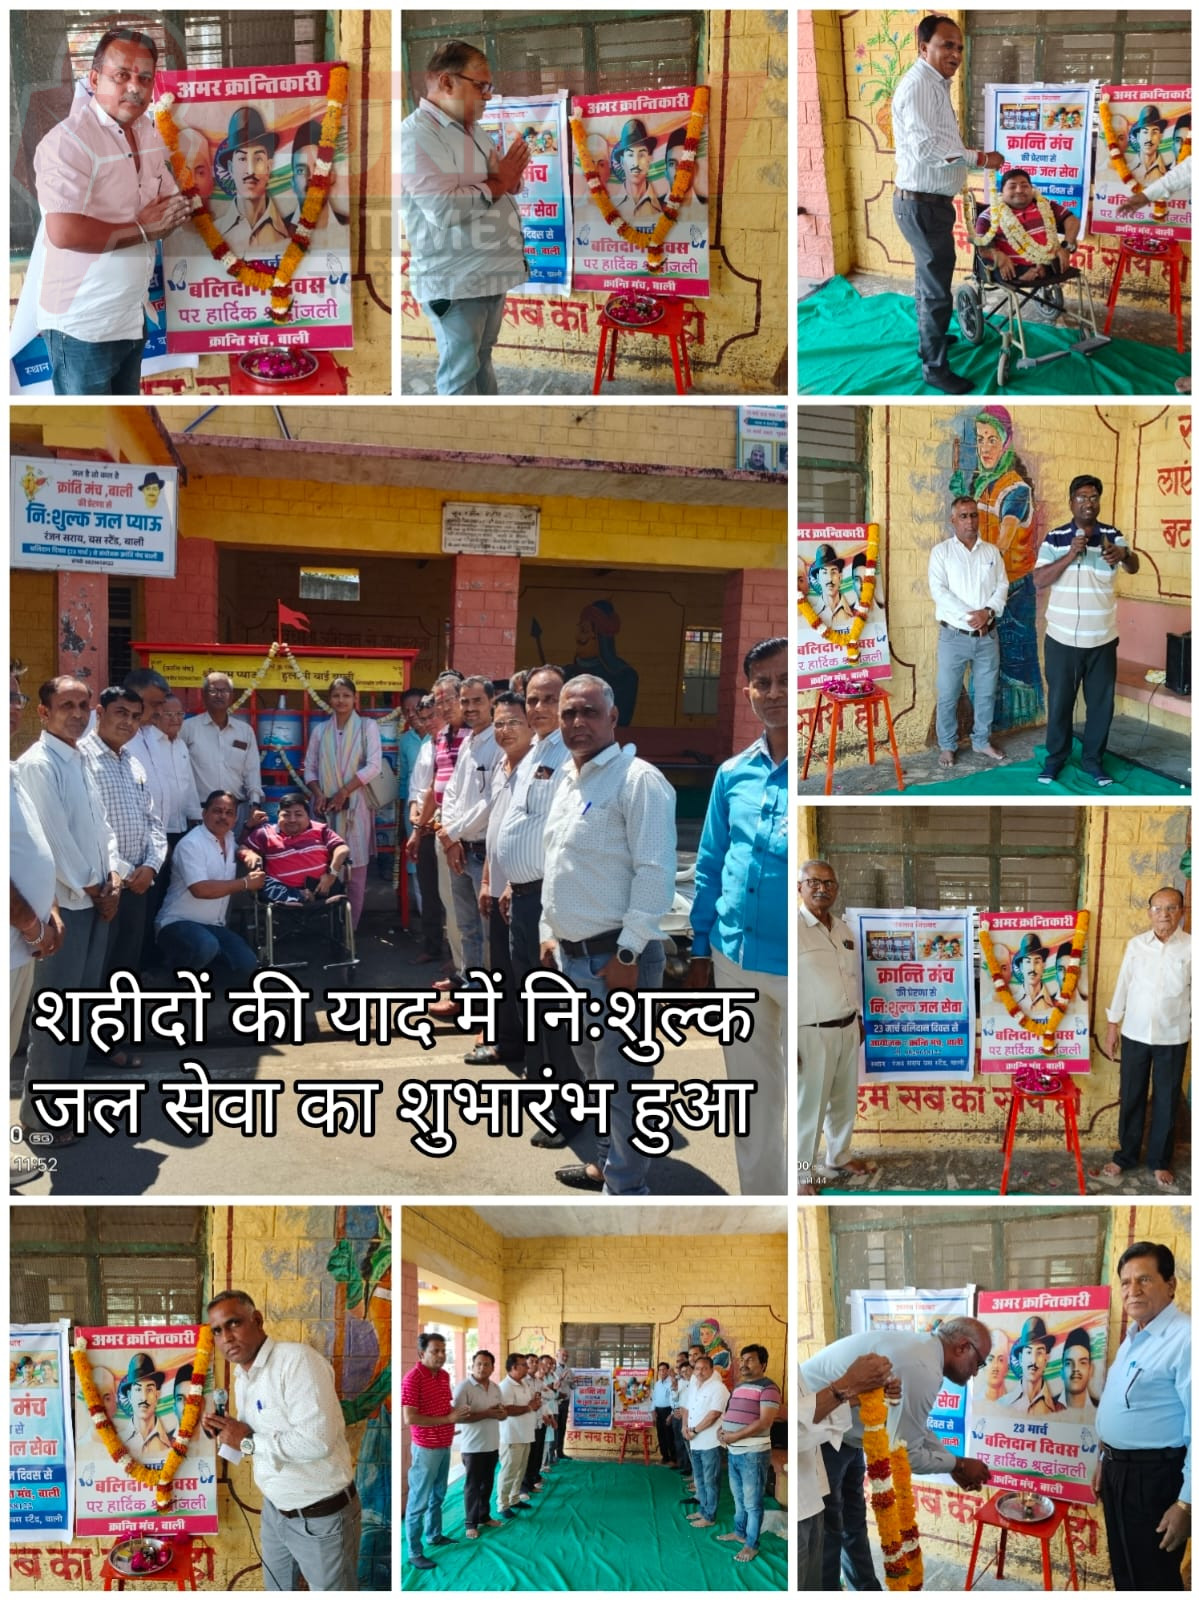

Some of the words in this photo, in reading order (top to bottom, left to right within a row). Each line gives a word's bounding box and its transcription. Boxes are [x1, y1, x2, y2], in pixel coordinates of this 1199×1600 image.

[177, 77, 224, 98] अमर
[225, 71, 322, 96] क्रान्तिकारी
[1113, 90, 1138, 100] अमर
[587, 101, 617, 114] अमर
[619, 93, 690, 111] क्रान्तिकारी
[1006, 132, 1047, 150] क्रान्ति
[1049, 134, 1074, 150] मंच
[1040, 165, 1057, 178] जल
[1059, 164, 1079, 178] सेवा
[534, 200, 557, 217] सेवा
[584, 259, 598, 270] पर
[602, 256, 638, 271] हार्दिक
[179, 309, 200, 323] पर
[206, 301, 257, 324] हार्दिक
[547, 299, 589, 334] का
[57, 479, 83, 495] क्रांति
[84, 482, 103, 495] मंच
[93, 512, 122, 529] जल
[125, 514, 163, 532] प्याऊ
[797, 528, 812, 539] मर
[812, 526, 865, 539] क्रान्तिकारी
[808, 656, 839, 671] हार्दिक
[993, 917, 1018, 928] अमर
[1019, 915, 1073, 927] क्रान्तिकारी
[876, 963, 925, 984] क्रान्ति
[927, 964, 955, 983] मंच
[919, 1000, 939, 1013] जल
[941, 998, 962, 1014] सेवा
[874, 1024, 882, 1033] 23
[885, 1023, 900, 1033] मार्च
[901, 1023, 930, 1033] बलिदान
[931, 1023, 950, 1033] दिवस
[951, 1023, 958, 1032] से
[989, 1046, 1002, 1055] पर
[896, 1085, 946, 1114] सब
[950, 1086, 985, 1114] का
[992, 1297, 1021, 1310] अमर
[1022, 1291, 1091, 1309] क्रान्तिकारी
[92, 1333, 124, 1346] अमर
[126, 1330, 196, 1345] क्रान्तिकारी
[13, 1393, 47, 1417] मंच
[937, 1390, 960, 1408] सेवा
[15, 1423, 24, 1434] से
[927, 1416, 945, 1430] दिवस
[946, 1417, 954, 1430] से
[1013, 1423, 1025, 1433] 23
[1026, 1422, 1049, 1435] मार्च
[604, 1431, 616, 1444] का
[985, 1433, 1037, 1453] बलिदान
[1039, 1437, 1081, 1458] दिवस
[30, 1436, 57, 1456] सेवा
[993, 1451, 1028, 1469] हार्दिक
[1031, 1460, 1087, 1479] श्रद्धांजली
[17, 1470, 45, 1481] दिवस
[46, 1469, 53, 1480] से
[993, 1475, 1018, 1487] क्रान्ति
[86, 1501, 103, 1513] पर
[107, 1495, 146, 1513] हार्दिक
[46, 1548, 93, 1582] का
